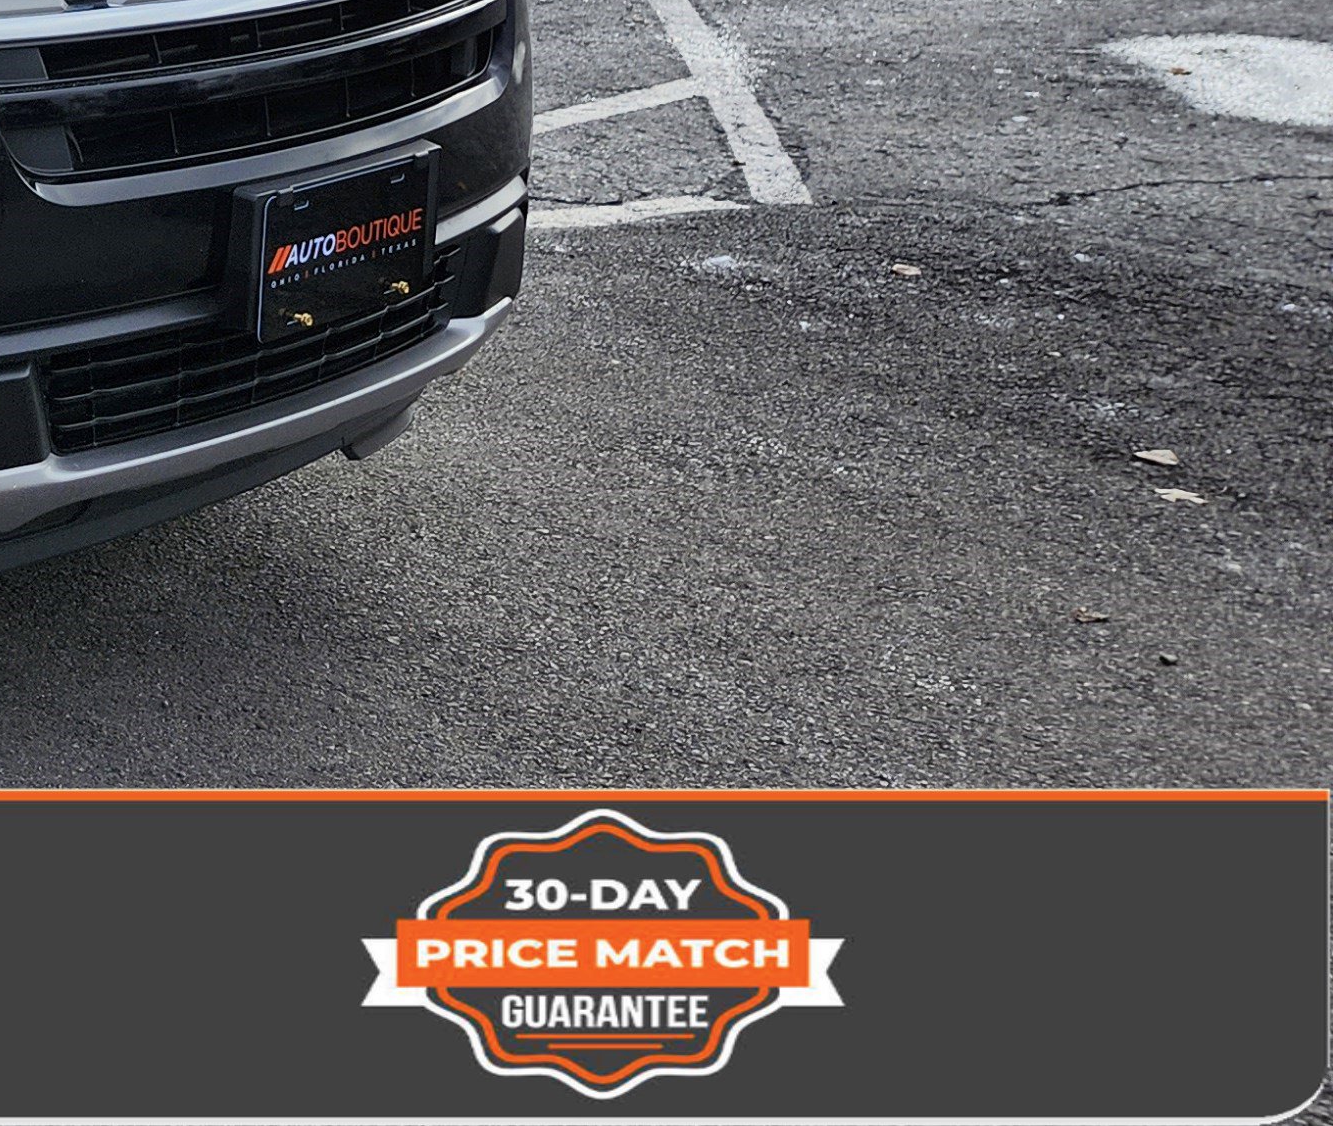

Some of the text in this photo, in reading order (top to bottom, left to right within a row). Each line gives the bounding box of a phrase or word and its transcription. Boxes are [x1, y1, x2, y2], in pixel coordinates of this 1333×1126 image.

[270, 238, 417, 289] OHIO FLORIDA TEXAS
[284, 207, 424, 268] AUTOBOUTIQUE
